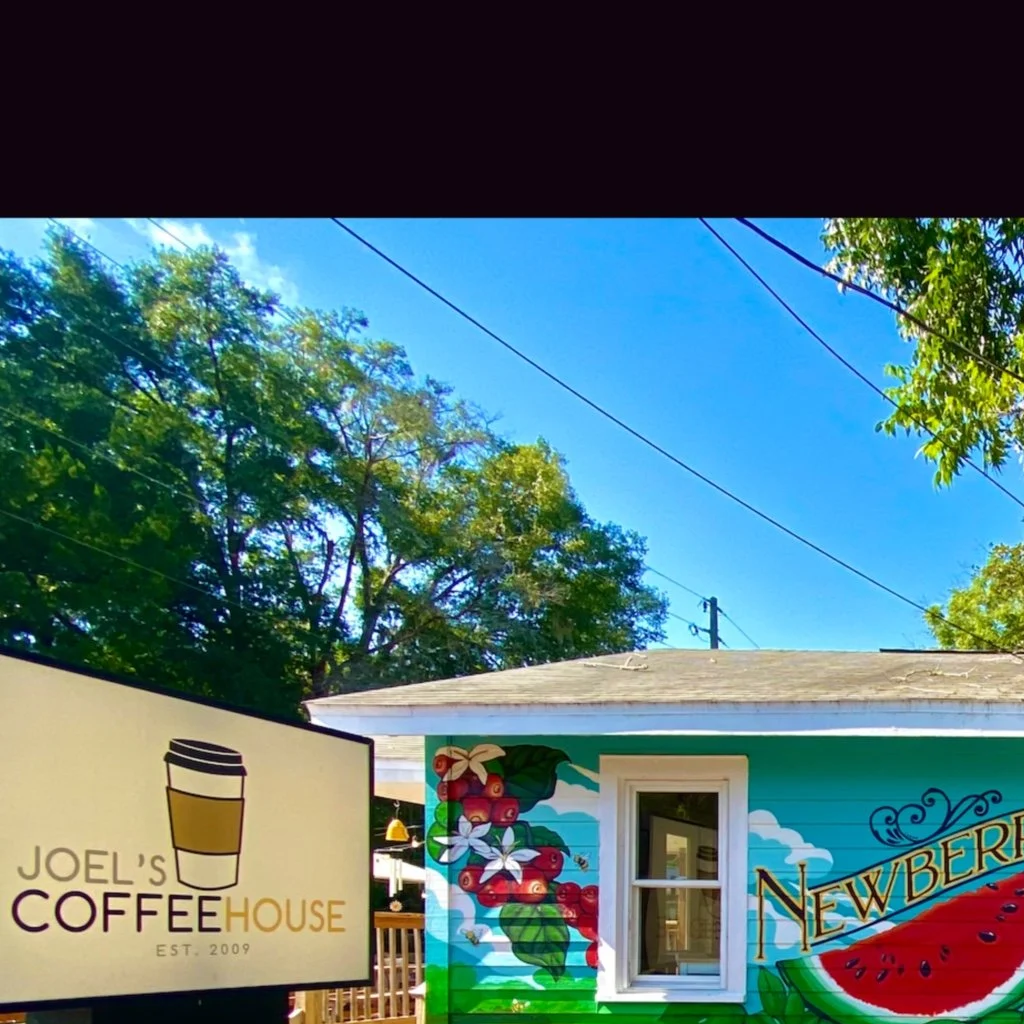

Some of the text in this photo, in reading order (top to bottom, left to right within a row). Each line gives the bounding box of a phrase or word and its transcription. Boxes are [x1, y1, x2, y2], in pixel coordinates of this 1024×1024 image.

[17, 845, 168, 887] JOEL'S
[156, 943, 251, 957] EST. 2009
